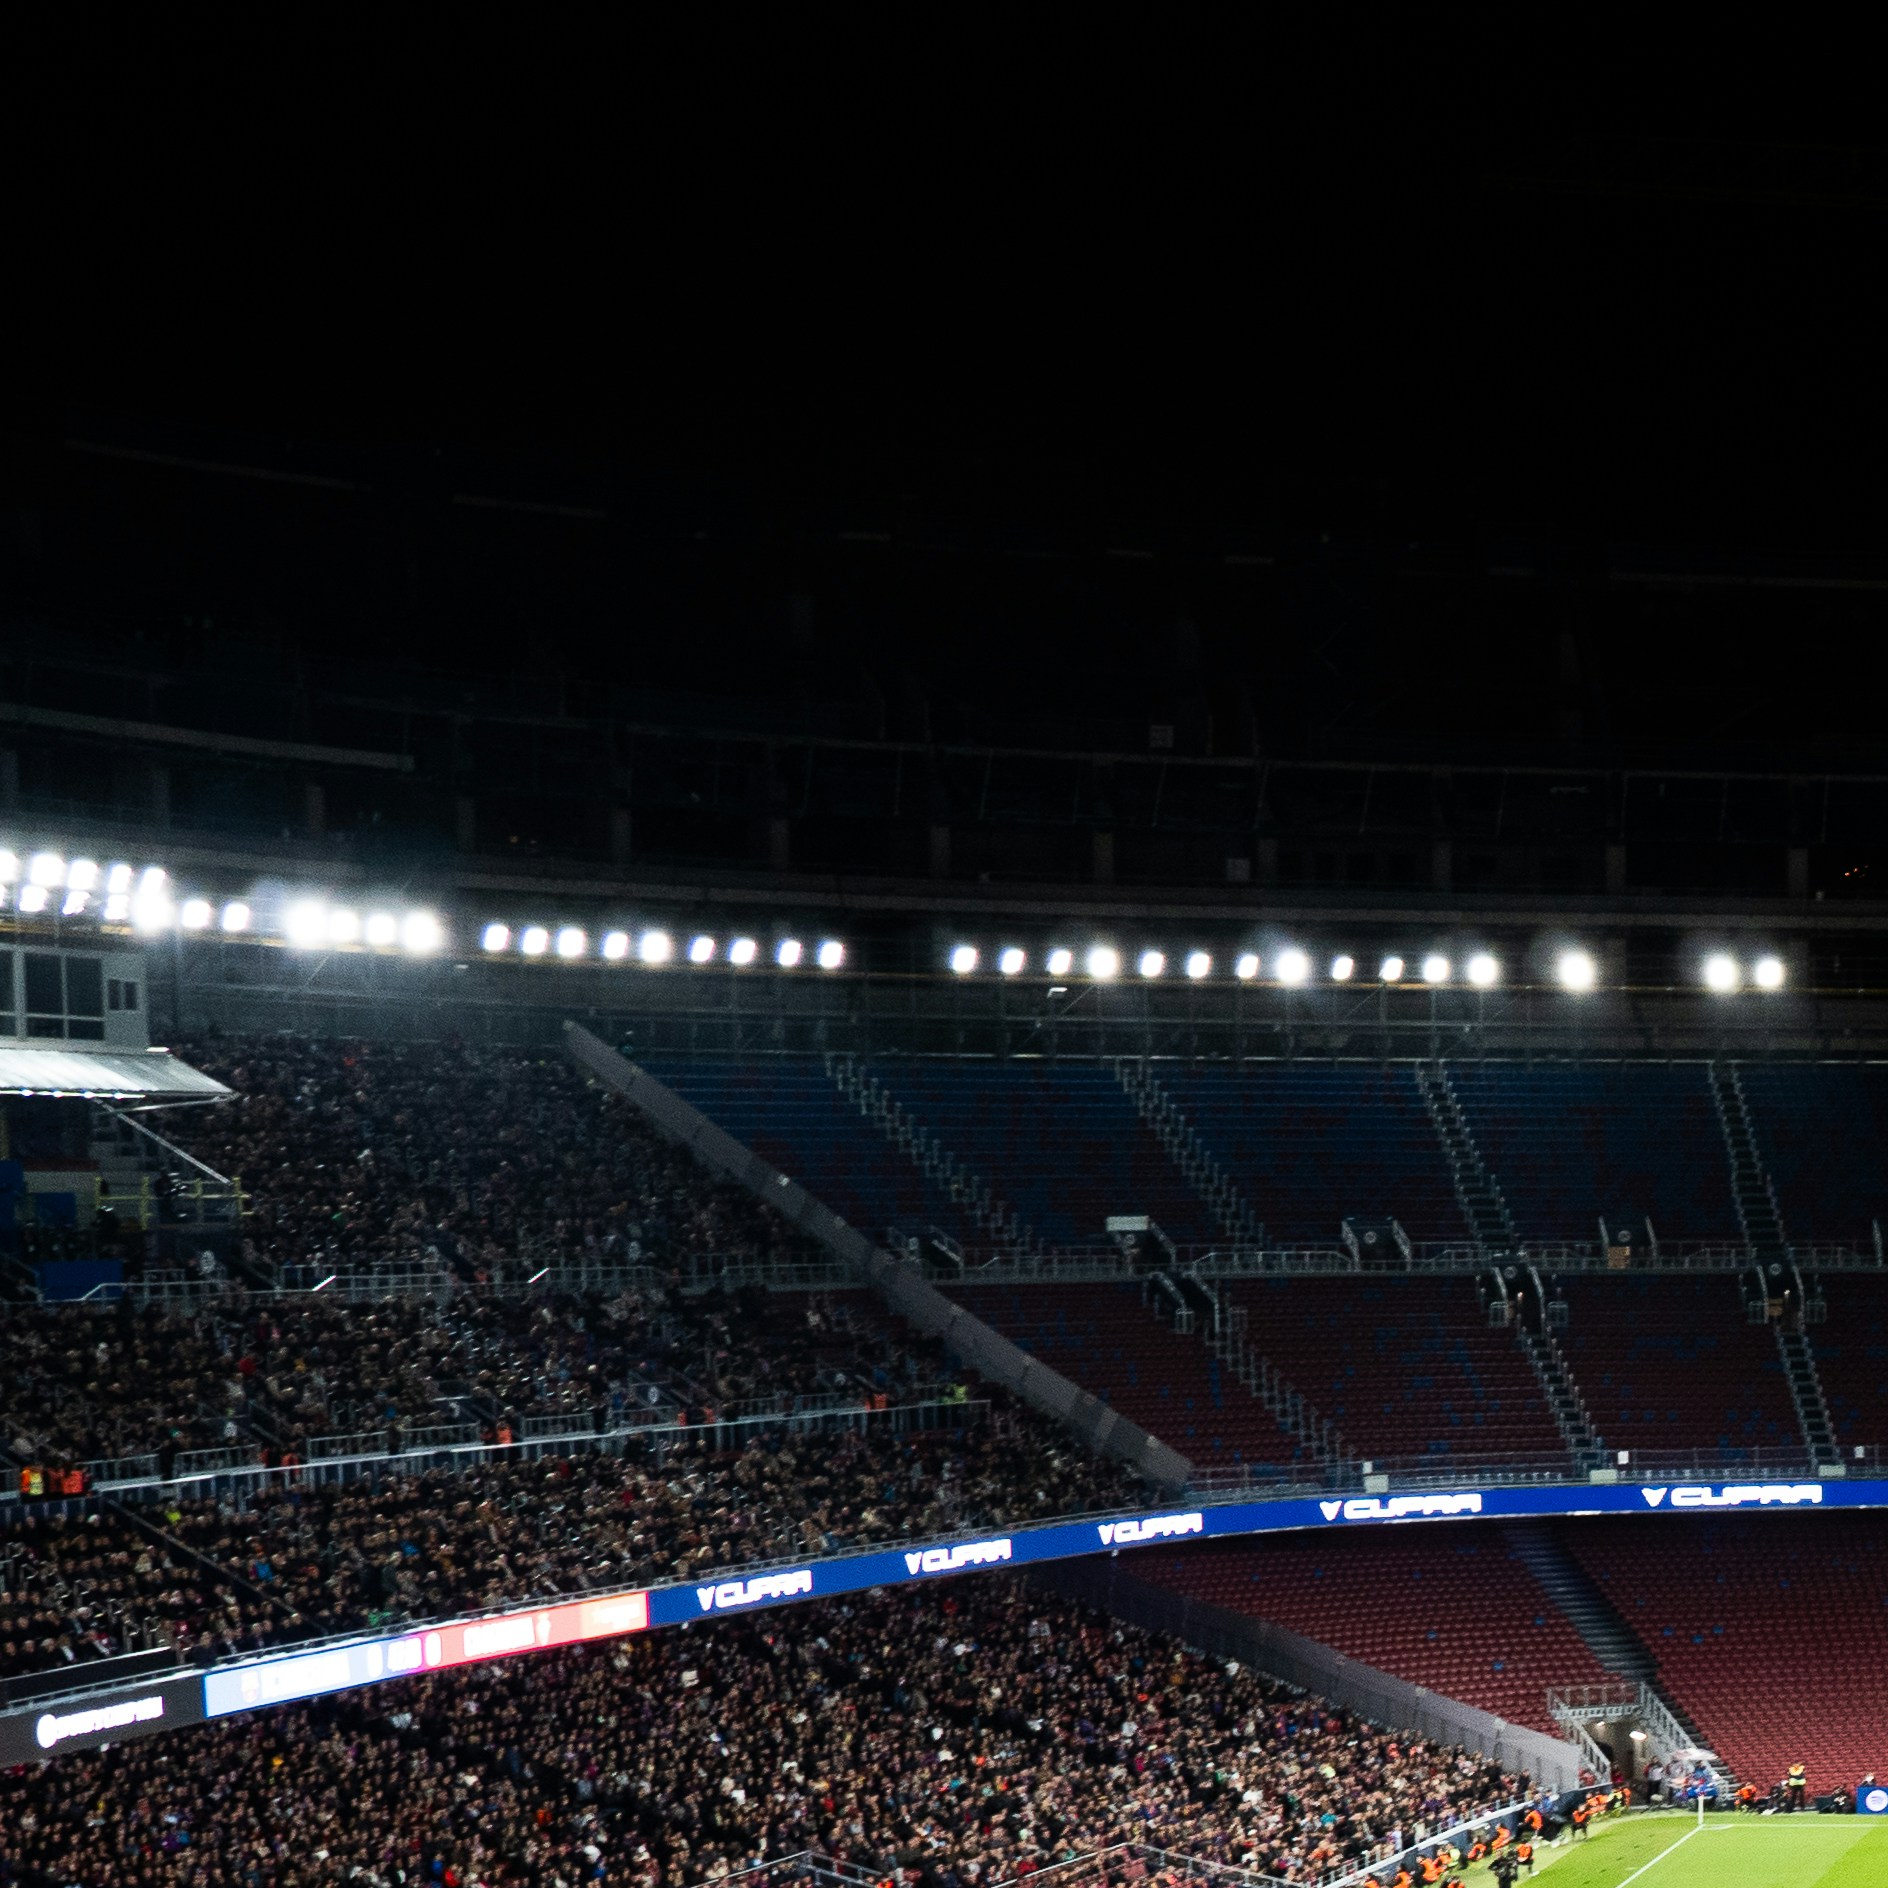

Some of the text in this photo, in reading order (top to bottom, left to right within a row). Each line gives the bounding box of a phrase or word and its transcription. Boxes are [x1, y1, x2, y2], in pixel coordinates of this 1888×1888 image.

[1344, 1494, 1481, 1522] CUPRA
[1671, 1485, 1822, 1506] CUPRA
[1125, 1513, 1202, 1542] CUPRA
[922, 1539, 1011, 1572] CUPRA
[714, 1570, 811, 1607] CUPRA
